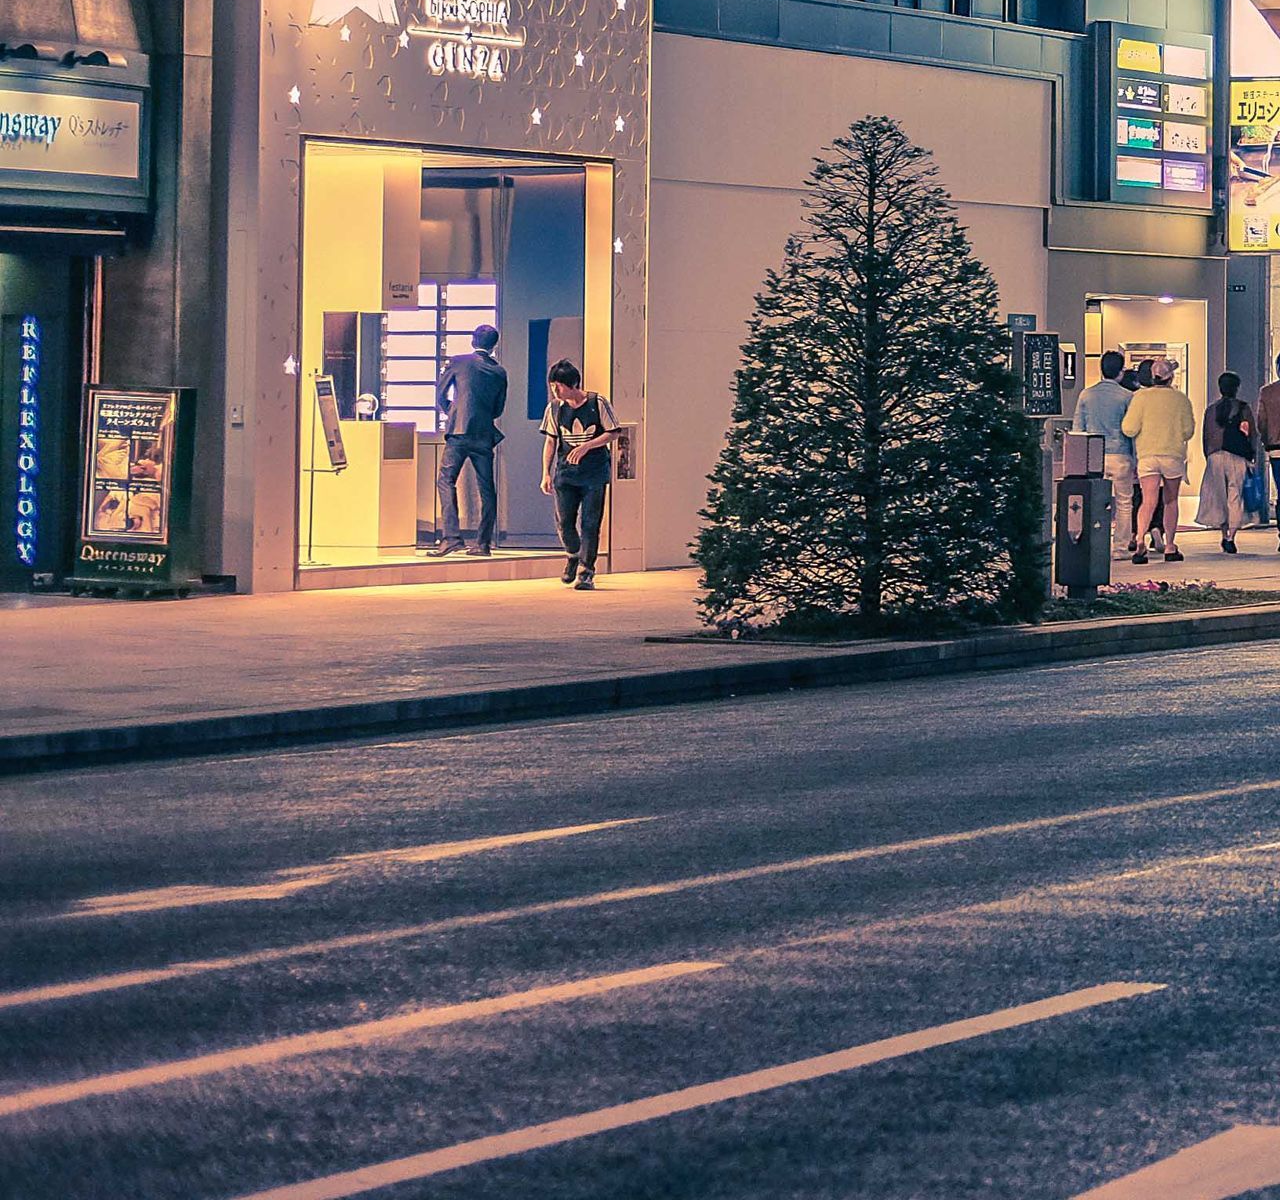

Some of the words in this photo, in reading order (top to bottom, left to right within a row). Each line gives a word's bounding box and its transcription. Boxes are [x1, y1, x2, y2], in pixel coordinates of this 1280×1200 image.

[430, 43, 506, 76] GINZA
[18, 320, 38, 564] REFLEXOLOGY
[80, 545, 166, 567] Queensway
